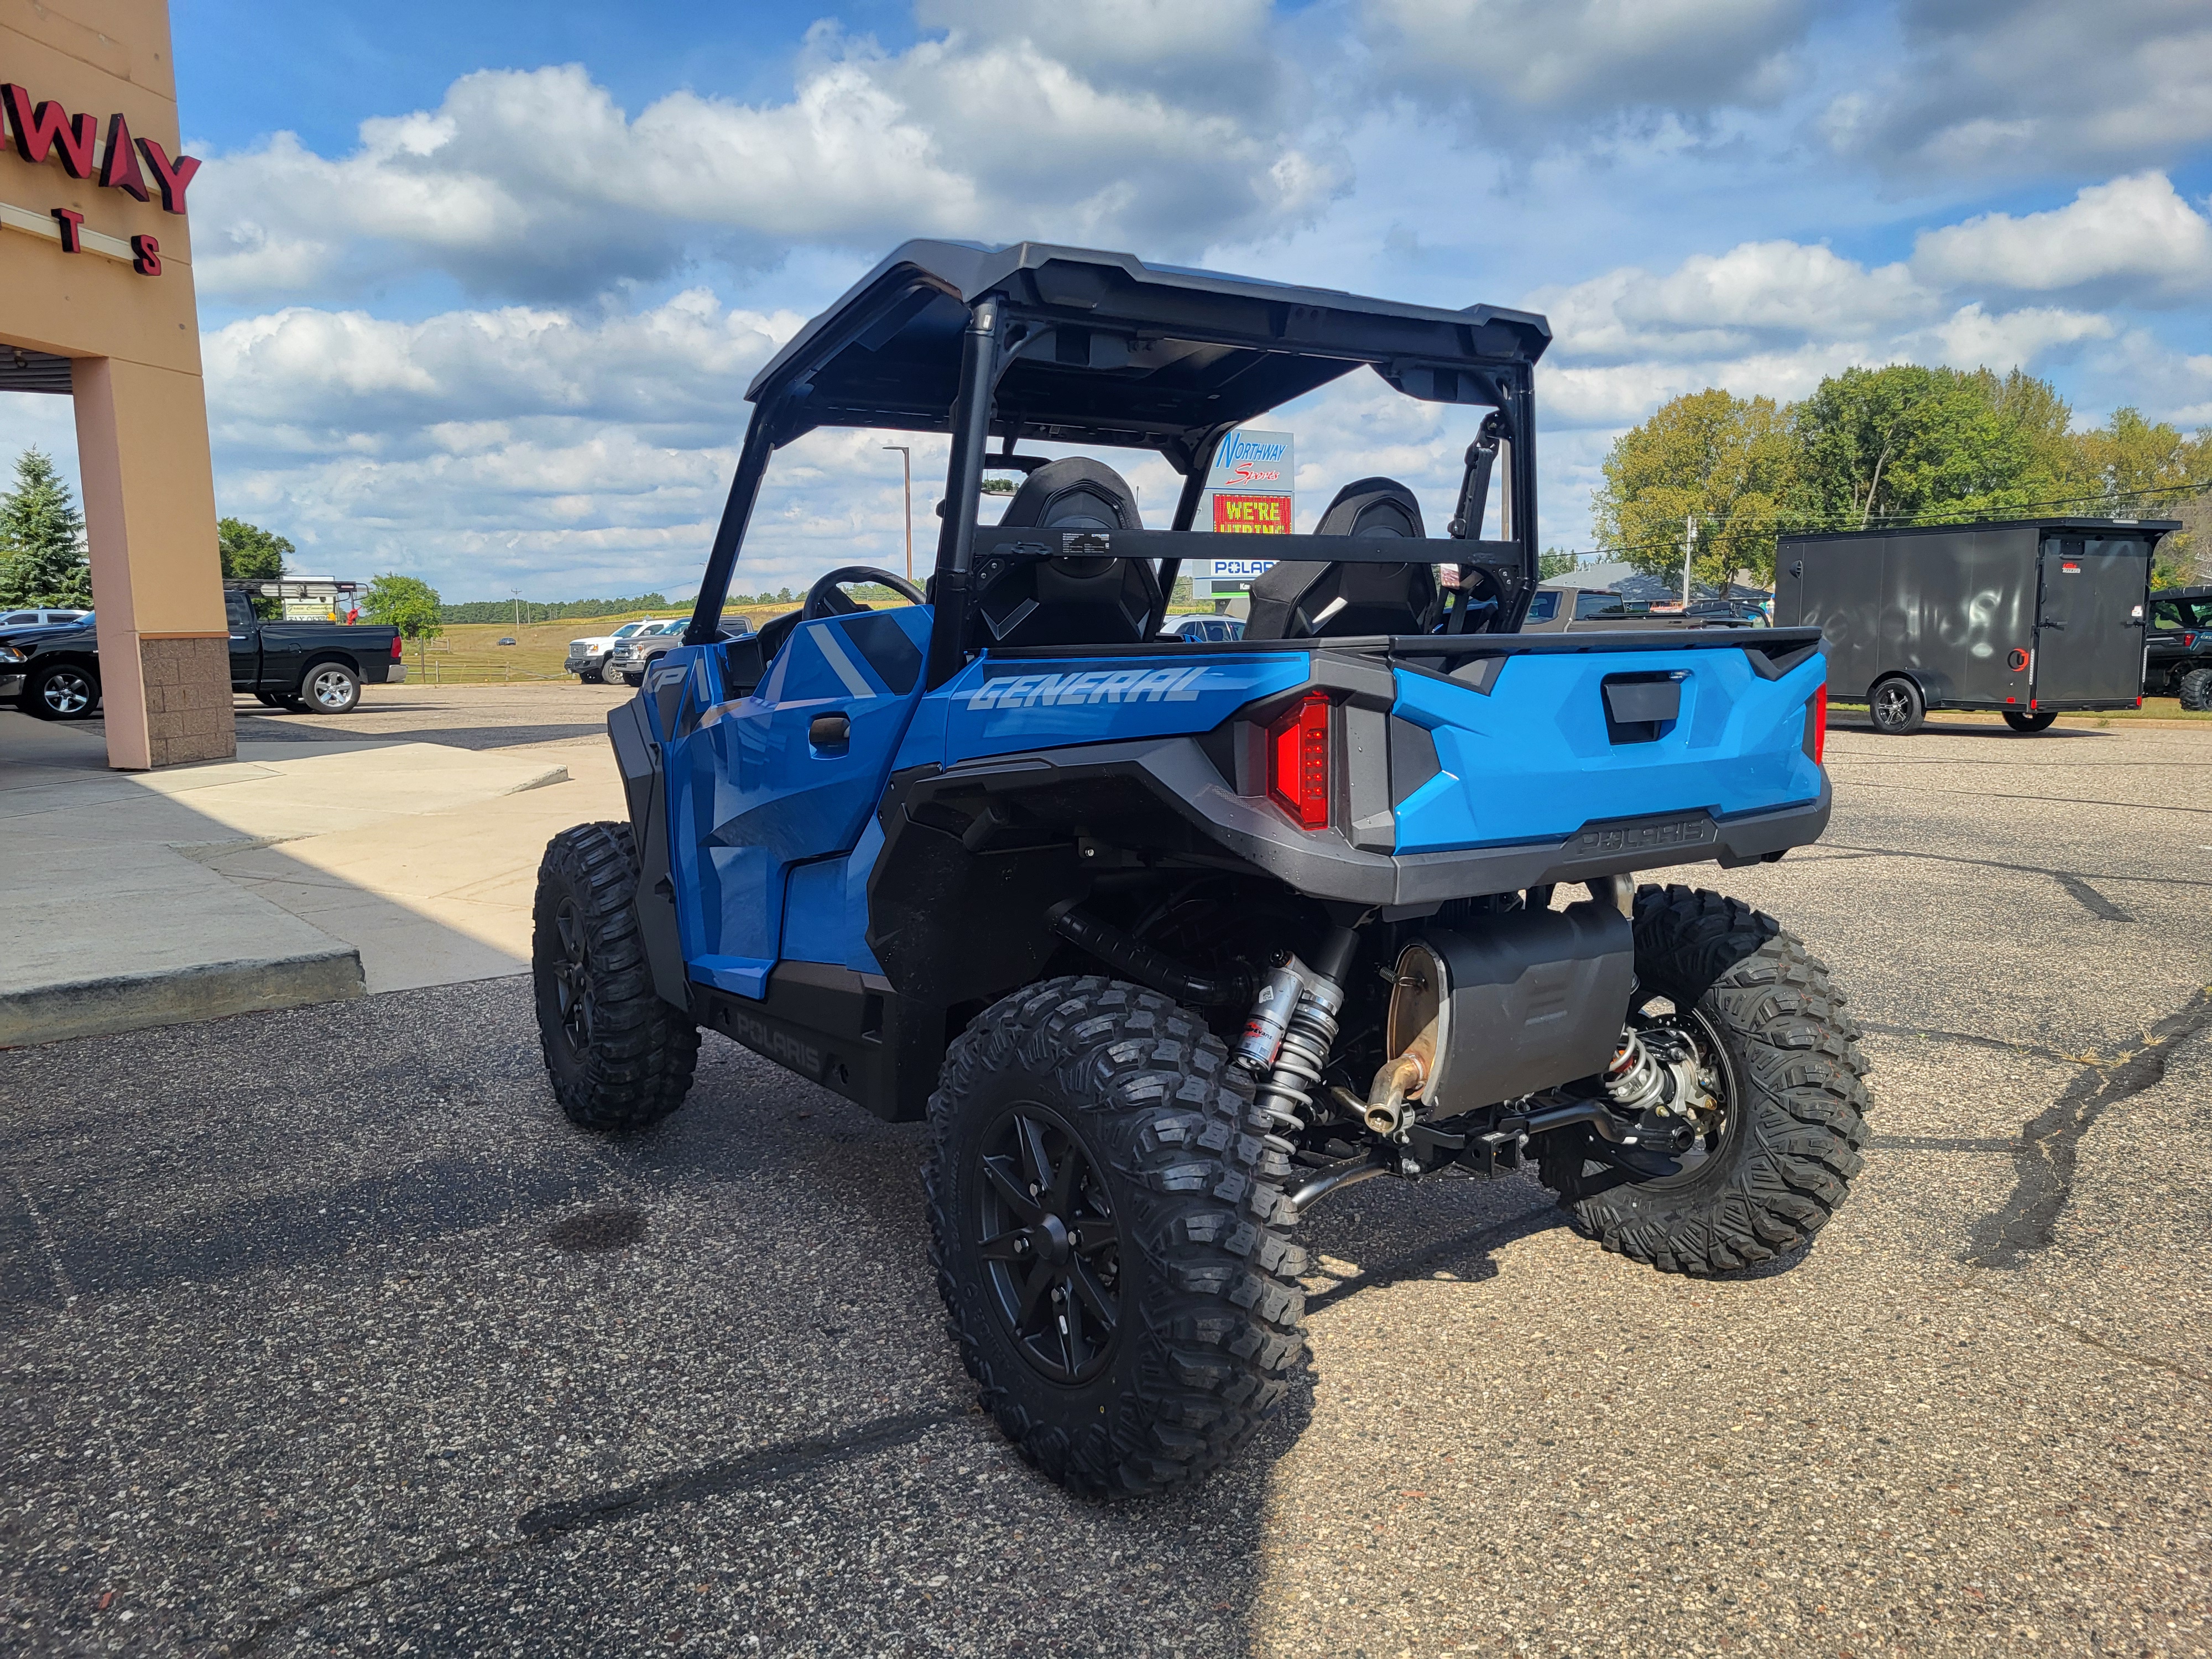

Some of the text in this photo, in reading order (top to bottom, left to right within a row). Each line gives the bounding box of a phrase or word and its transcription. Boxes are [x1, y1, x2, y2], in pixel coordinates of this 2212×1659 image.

[0, 83, 202, 215] WAY
[1215, 431, 1287, 469] NORTHWAY
[1224, 463, 1280, 486] Sports
[1226, 502, 1280, 520] WE'RE
[966, 666, 1210, 711] GENERAL
[1577, 820, 1704, 855] POLARIS
[736, 1013, 821, 1072] POLARIS
